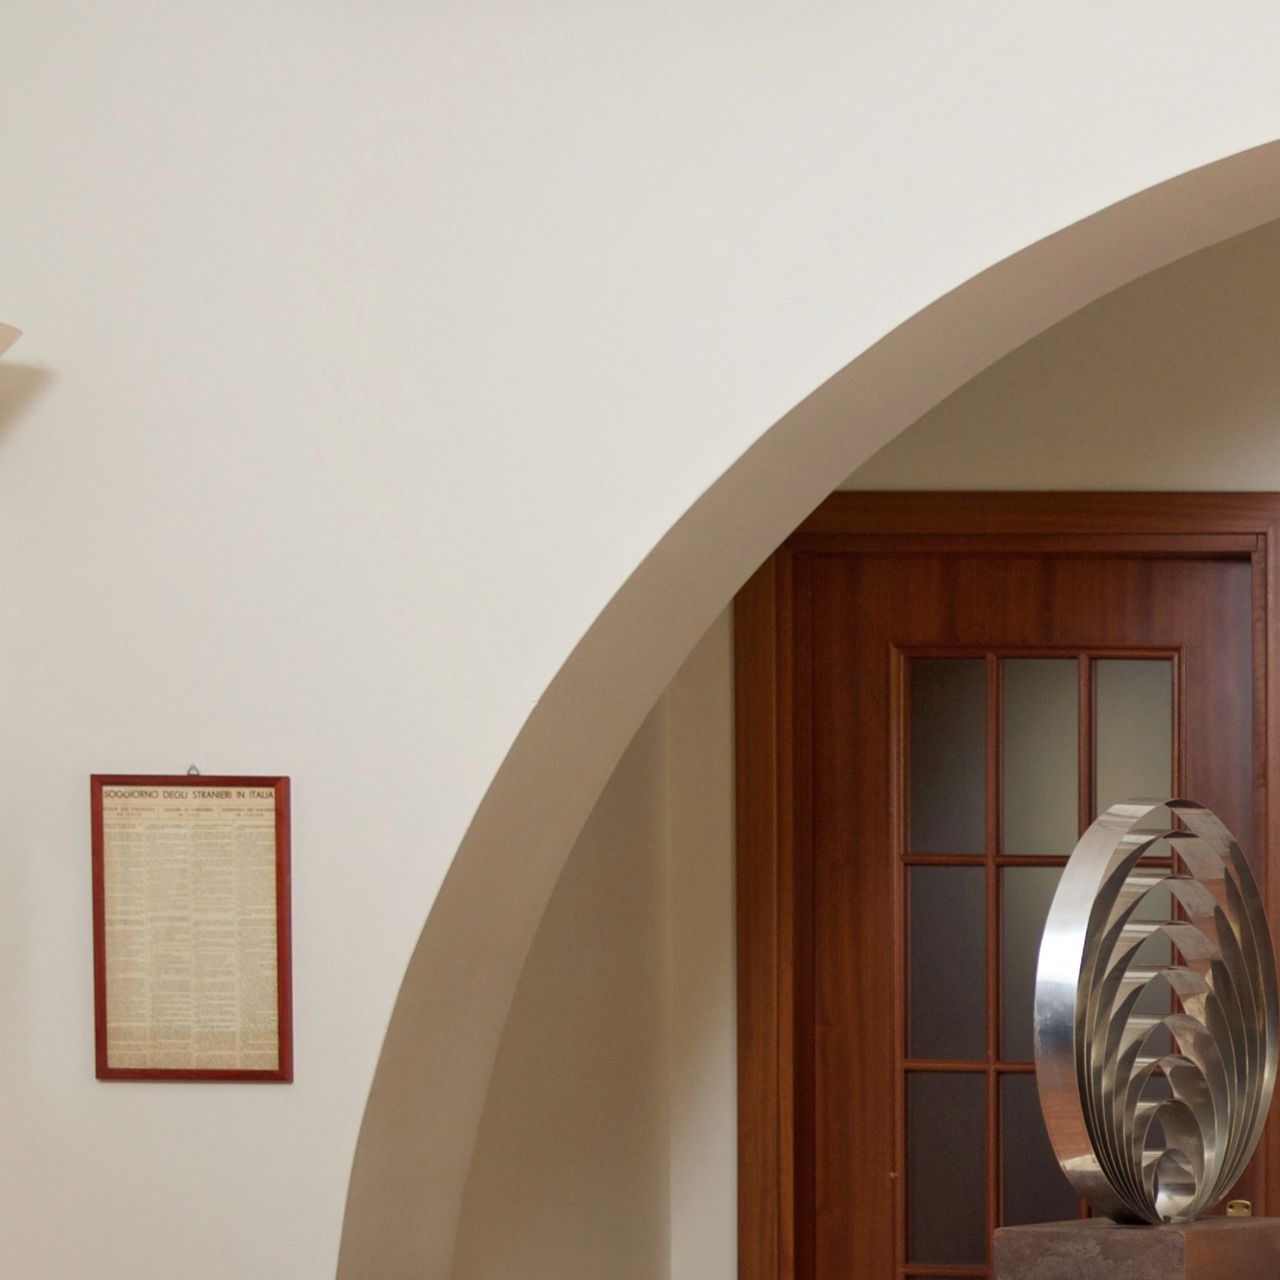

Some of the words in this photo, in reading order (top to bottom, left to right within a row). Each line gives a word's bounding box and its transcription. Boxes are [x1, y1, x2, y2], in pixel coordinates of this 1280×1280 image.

[104, 790, 159, 800] SOGGIORNO
[163, 791, 188, 800] DEGLI
[192, 791, 232, 800] STRANIERI
[236, 791, 245, 800] IN
[249, 791, 274, 800] ITALIA
